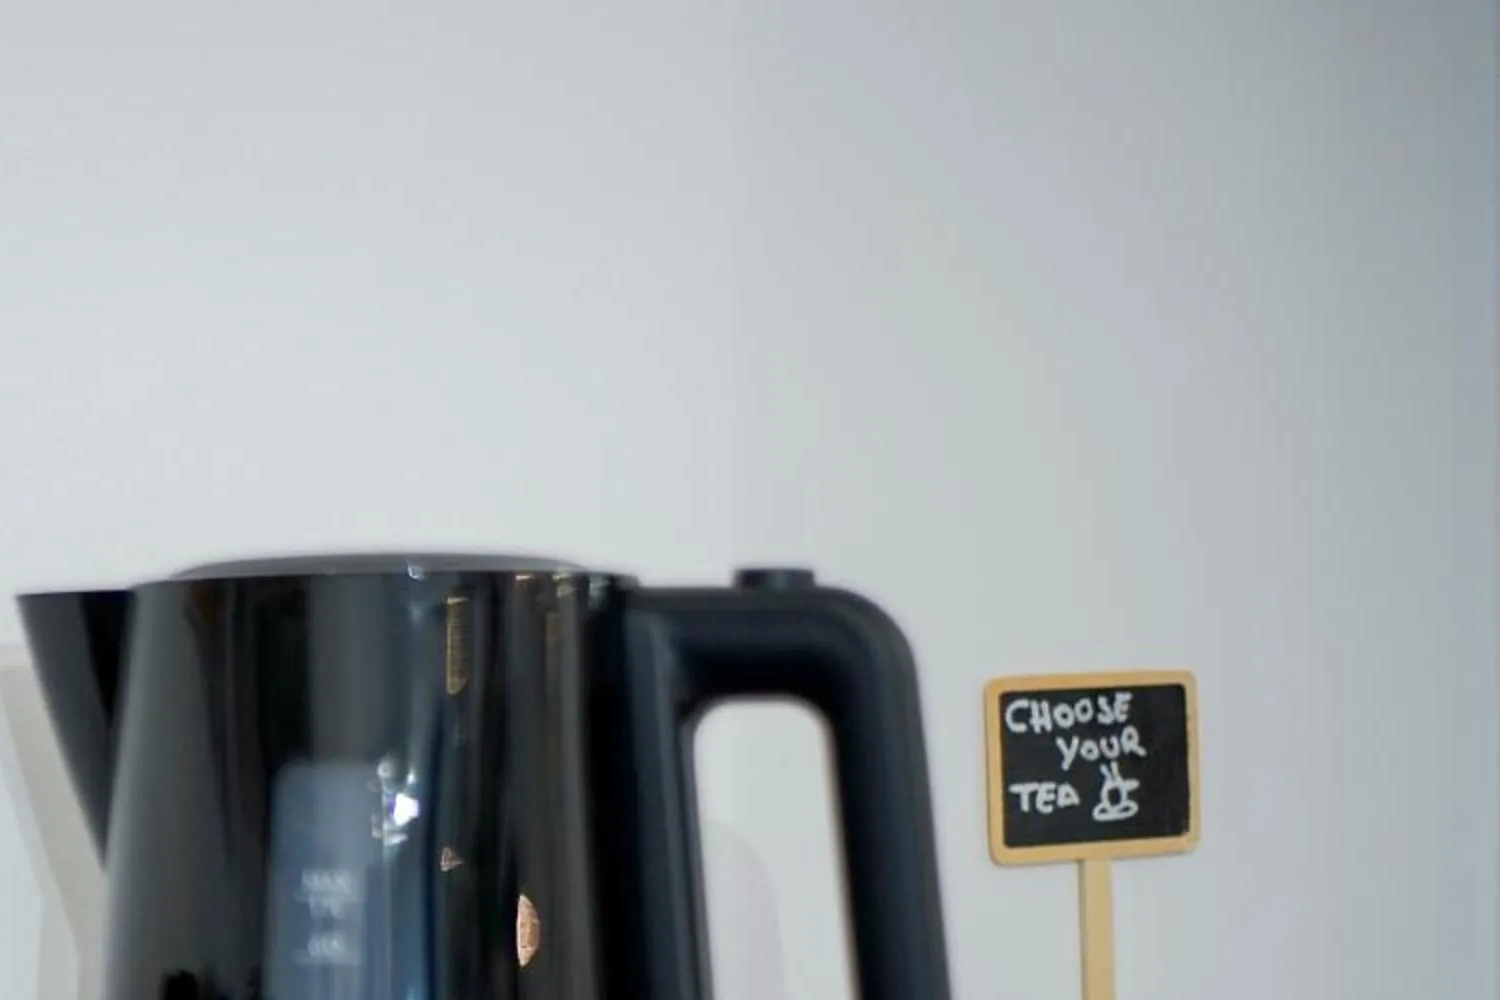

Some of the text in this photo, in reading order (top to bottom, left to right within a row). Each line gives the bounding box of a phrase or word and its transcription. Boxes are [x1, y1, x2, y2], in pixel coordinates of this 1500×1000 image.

[1004, 691, 1133, 734] CHOOSE
[1055, 725, 1148, 772] YOUR
[1008, 781, 1081, 814] TEA
